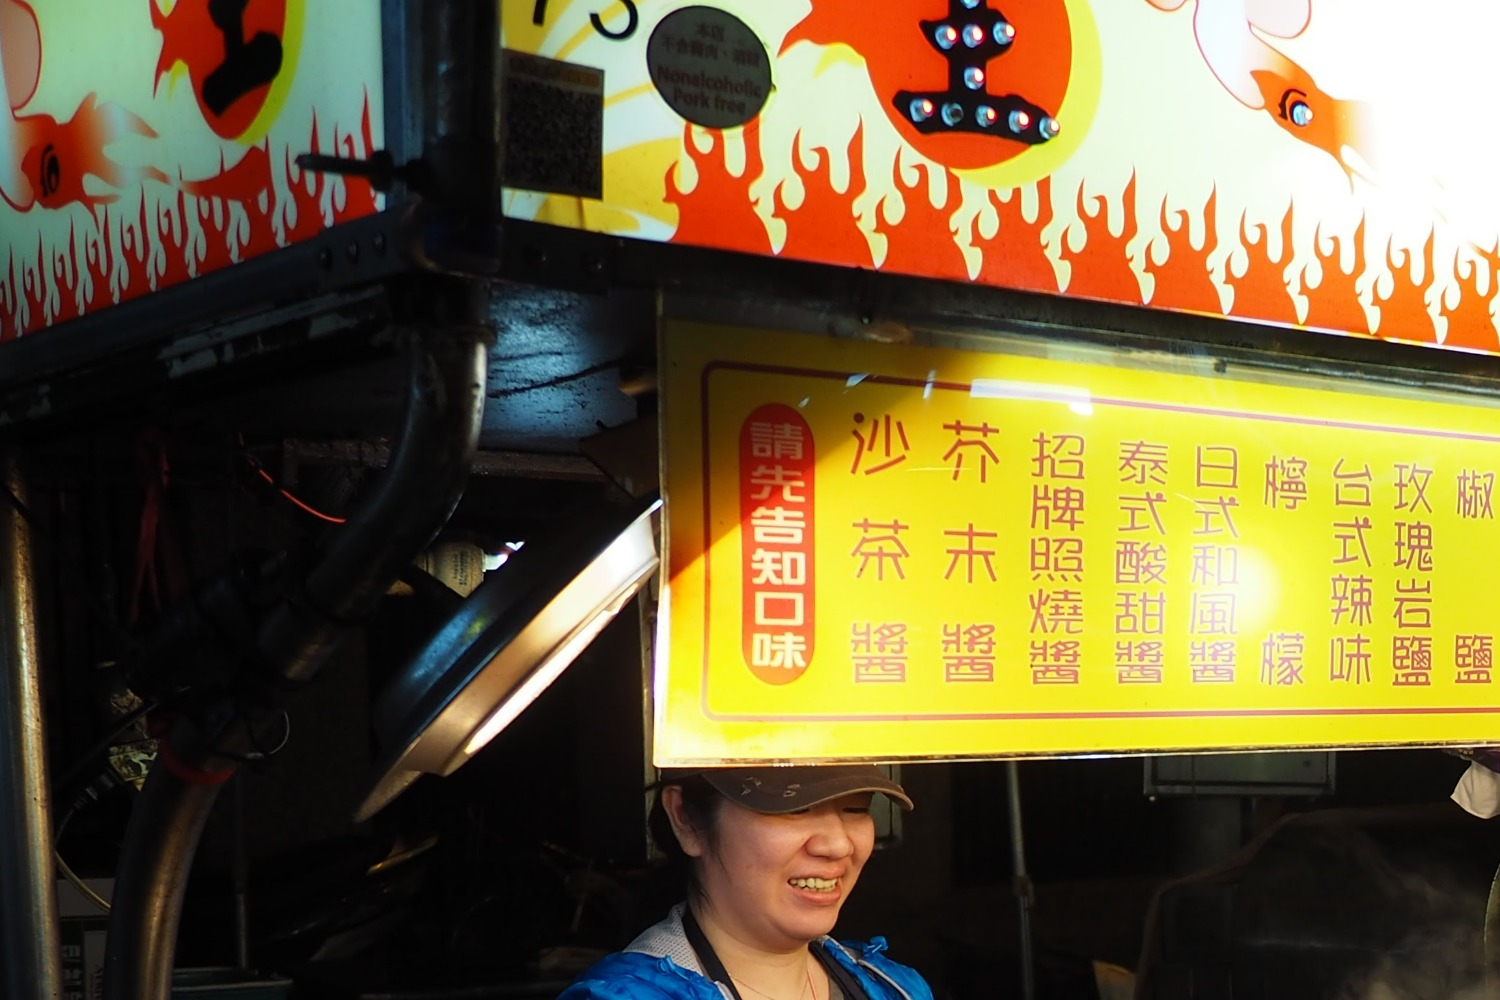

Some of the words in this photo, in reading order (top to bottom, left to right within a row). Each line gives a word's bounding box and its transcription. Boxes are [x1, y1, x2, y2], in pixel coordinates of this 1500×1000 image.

[657, 65, 761, 99] Nonalcoholic
[674, 86, 710, 110] Pork
[715, 96, 747, 114] free
[749, 420, 807, 669] 請先告知口味
[850, 412, 910, 683] 沙茶醬
[942, 419, 999, 683] 芥末醬
[1029, 431, 1085, 685] 招牌照燒醬
[1115, 439, 1169, 684] 泰式酸甜醬
[1189, 445, 1240, 683] 日式和風醬
[1259, 456, 1309, 686] 檸檬
[1330, 458, 1373, 686] 台式辣味
[1391, 461, 1435, 687] 玫瑰岩鹽
[1454, 470, 1496, 686] 椒鹽
